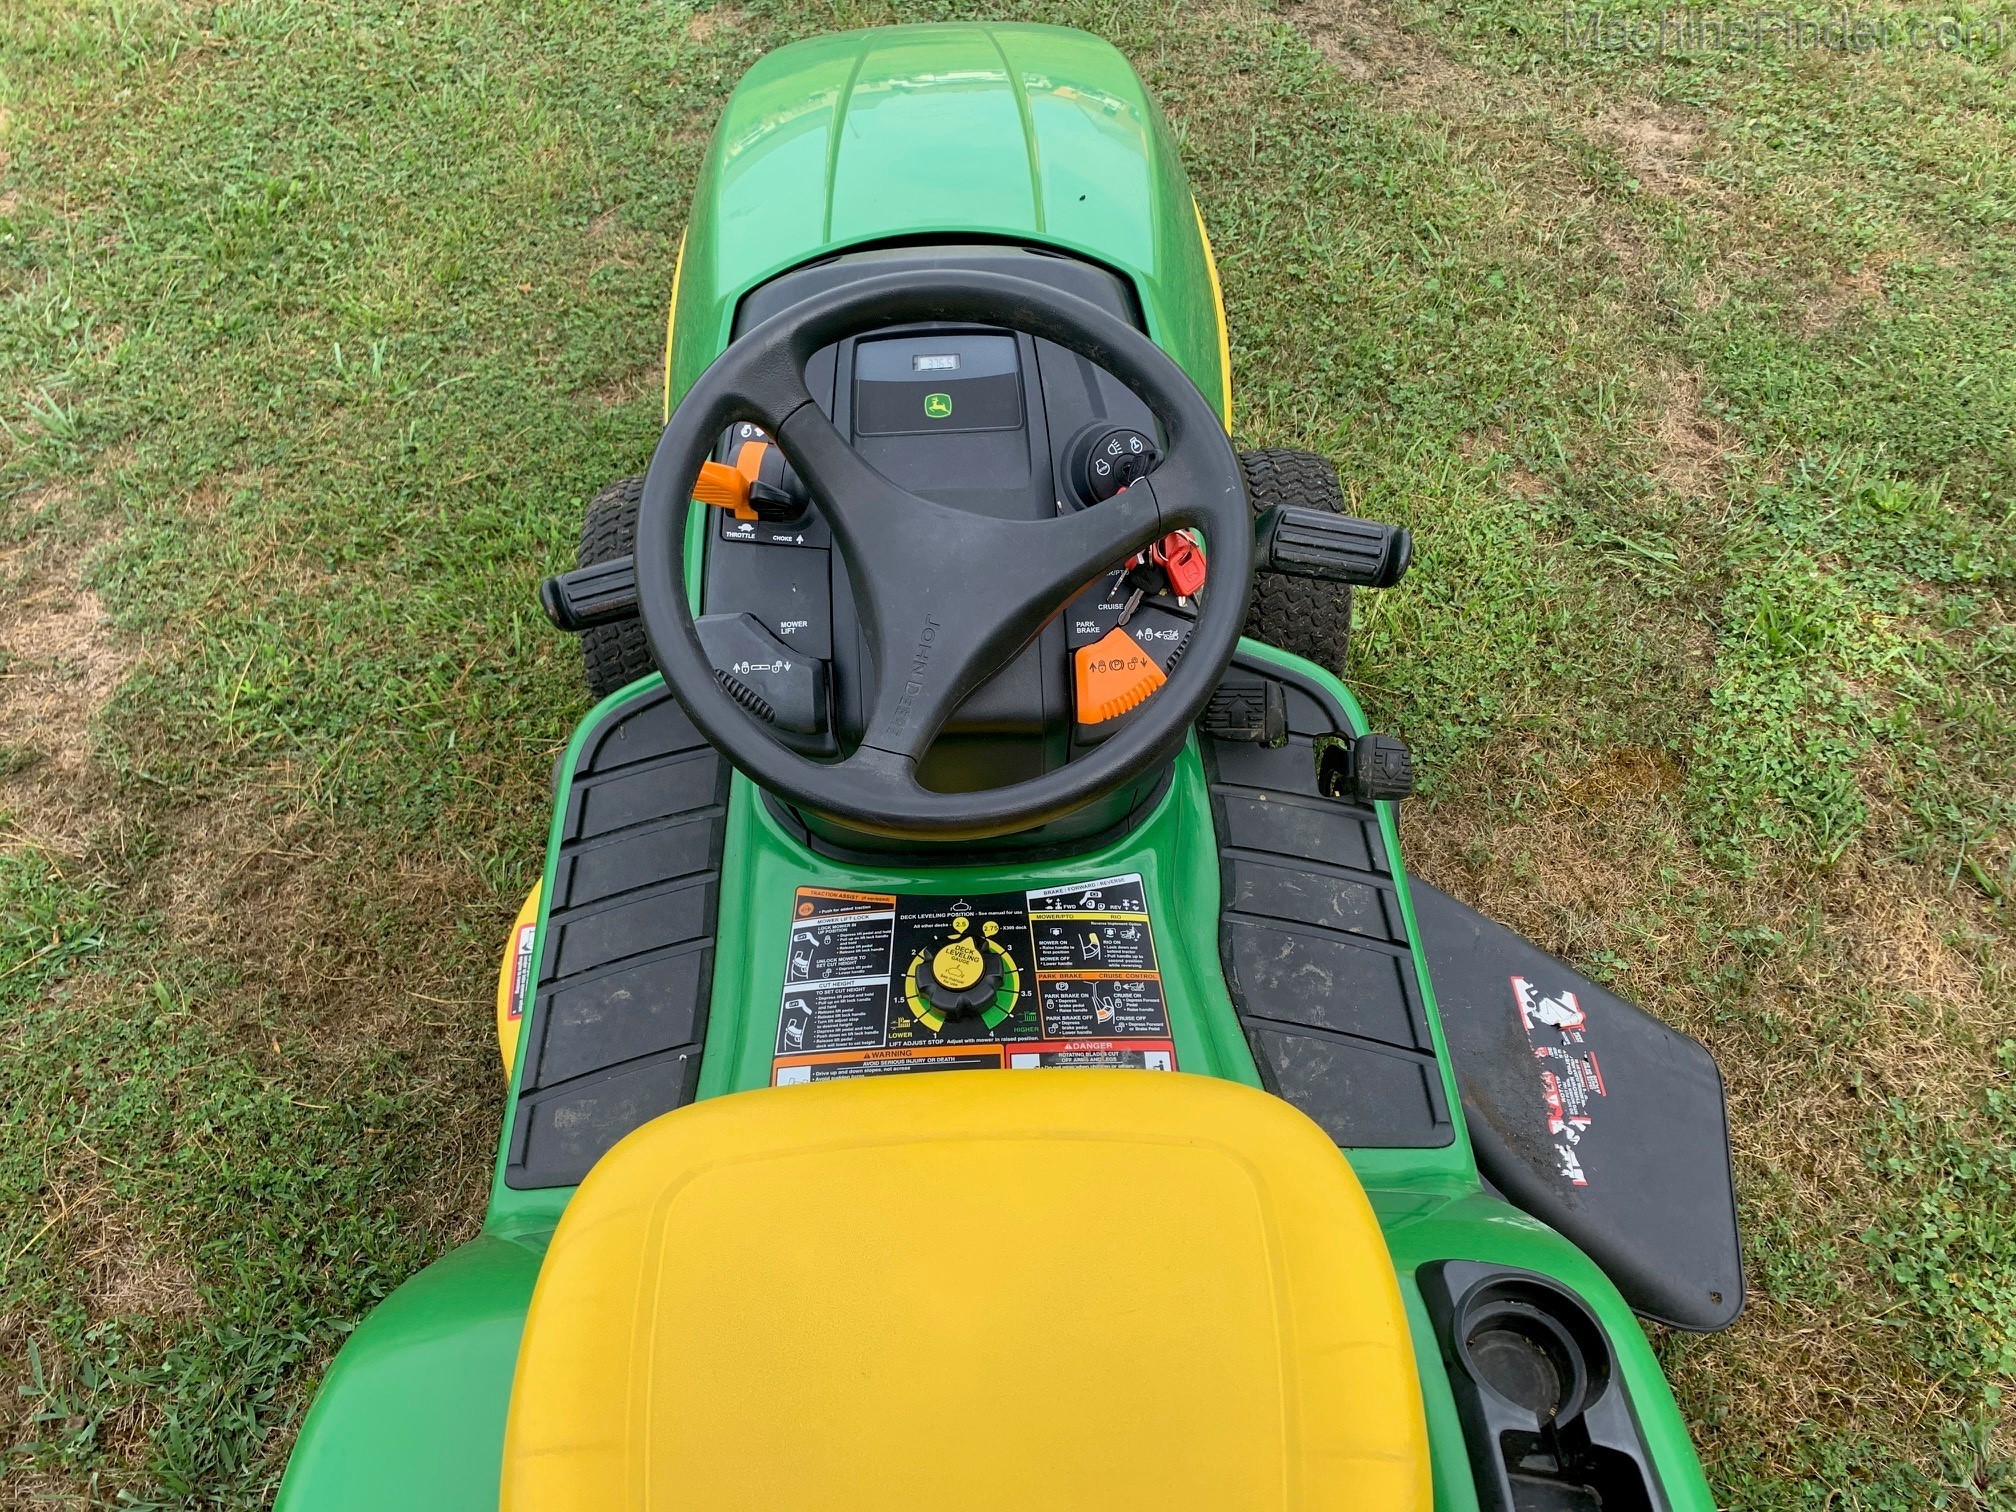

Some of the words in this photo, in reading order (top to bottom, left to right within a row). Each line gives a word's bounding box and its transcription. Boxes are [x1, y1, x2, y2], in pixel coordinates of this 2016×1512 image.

[910, 614, 940, 677] JOHN
[955, 945, 974, 954] DECK
[946, 949, 979, 962] LEVELING
[951, 957, 969, 965] GAUGE
[872, 1050, 912, 1058] WARNING
[1570, 1076, 1581, 1104] THROWN
